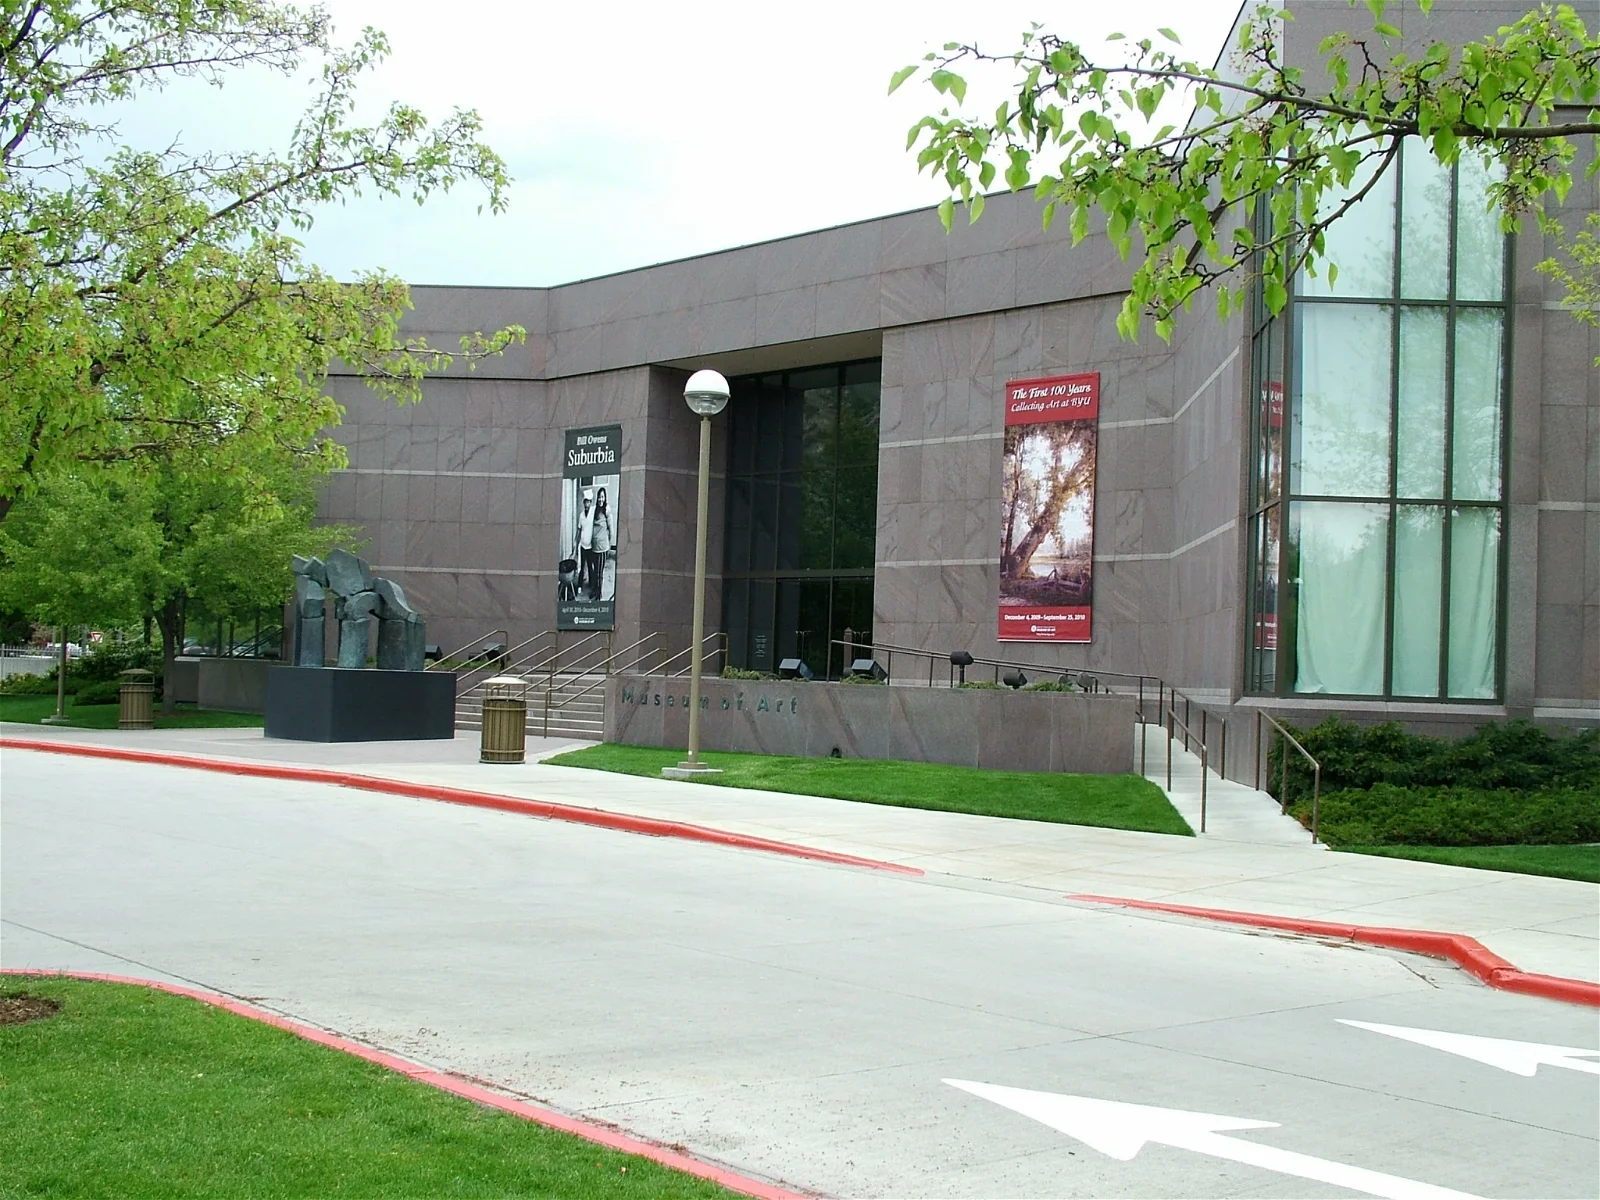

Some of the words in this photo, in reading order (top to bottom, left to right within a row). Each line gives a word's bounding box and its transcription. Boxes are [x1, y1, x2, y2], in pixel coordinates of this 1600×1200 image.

[1012, 388, 1027, 400] The
[1028, 387, 1048, 399] First
[1050, 385, 1066, 396] 100
[1067, 383, 1092, 397] Years
[1011, 401, 1045, 412] Collecting
[1046, 400, 1060, 409] Art
[1071, 397, 1091, 408] BYU
[577, 436, 587, 445] Bill
[588, 435, 607, 444] Owens
[568, 445, 614, 467] Suburbia
[621, 687, 709, 710] Museum
[721, 692, 743, 711] of
[757, 692, 797, 714] Art
